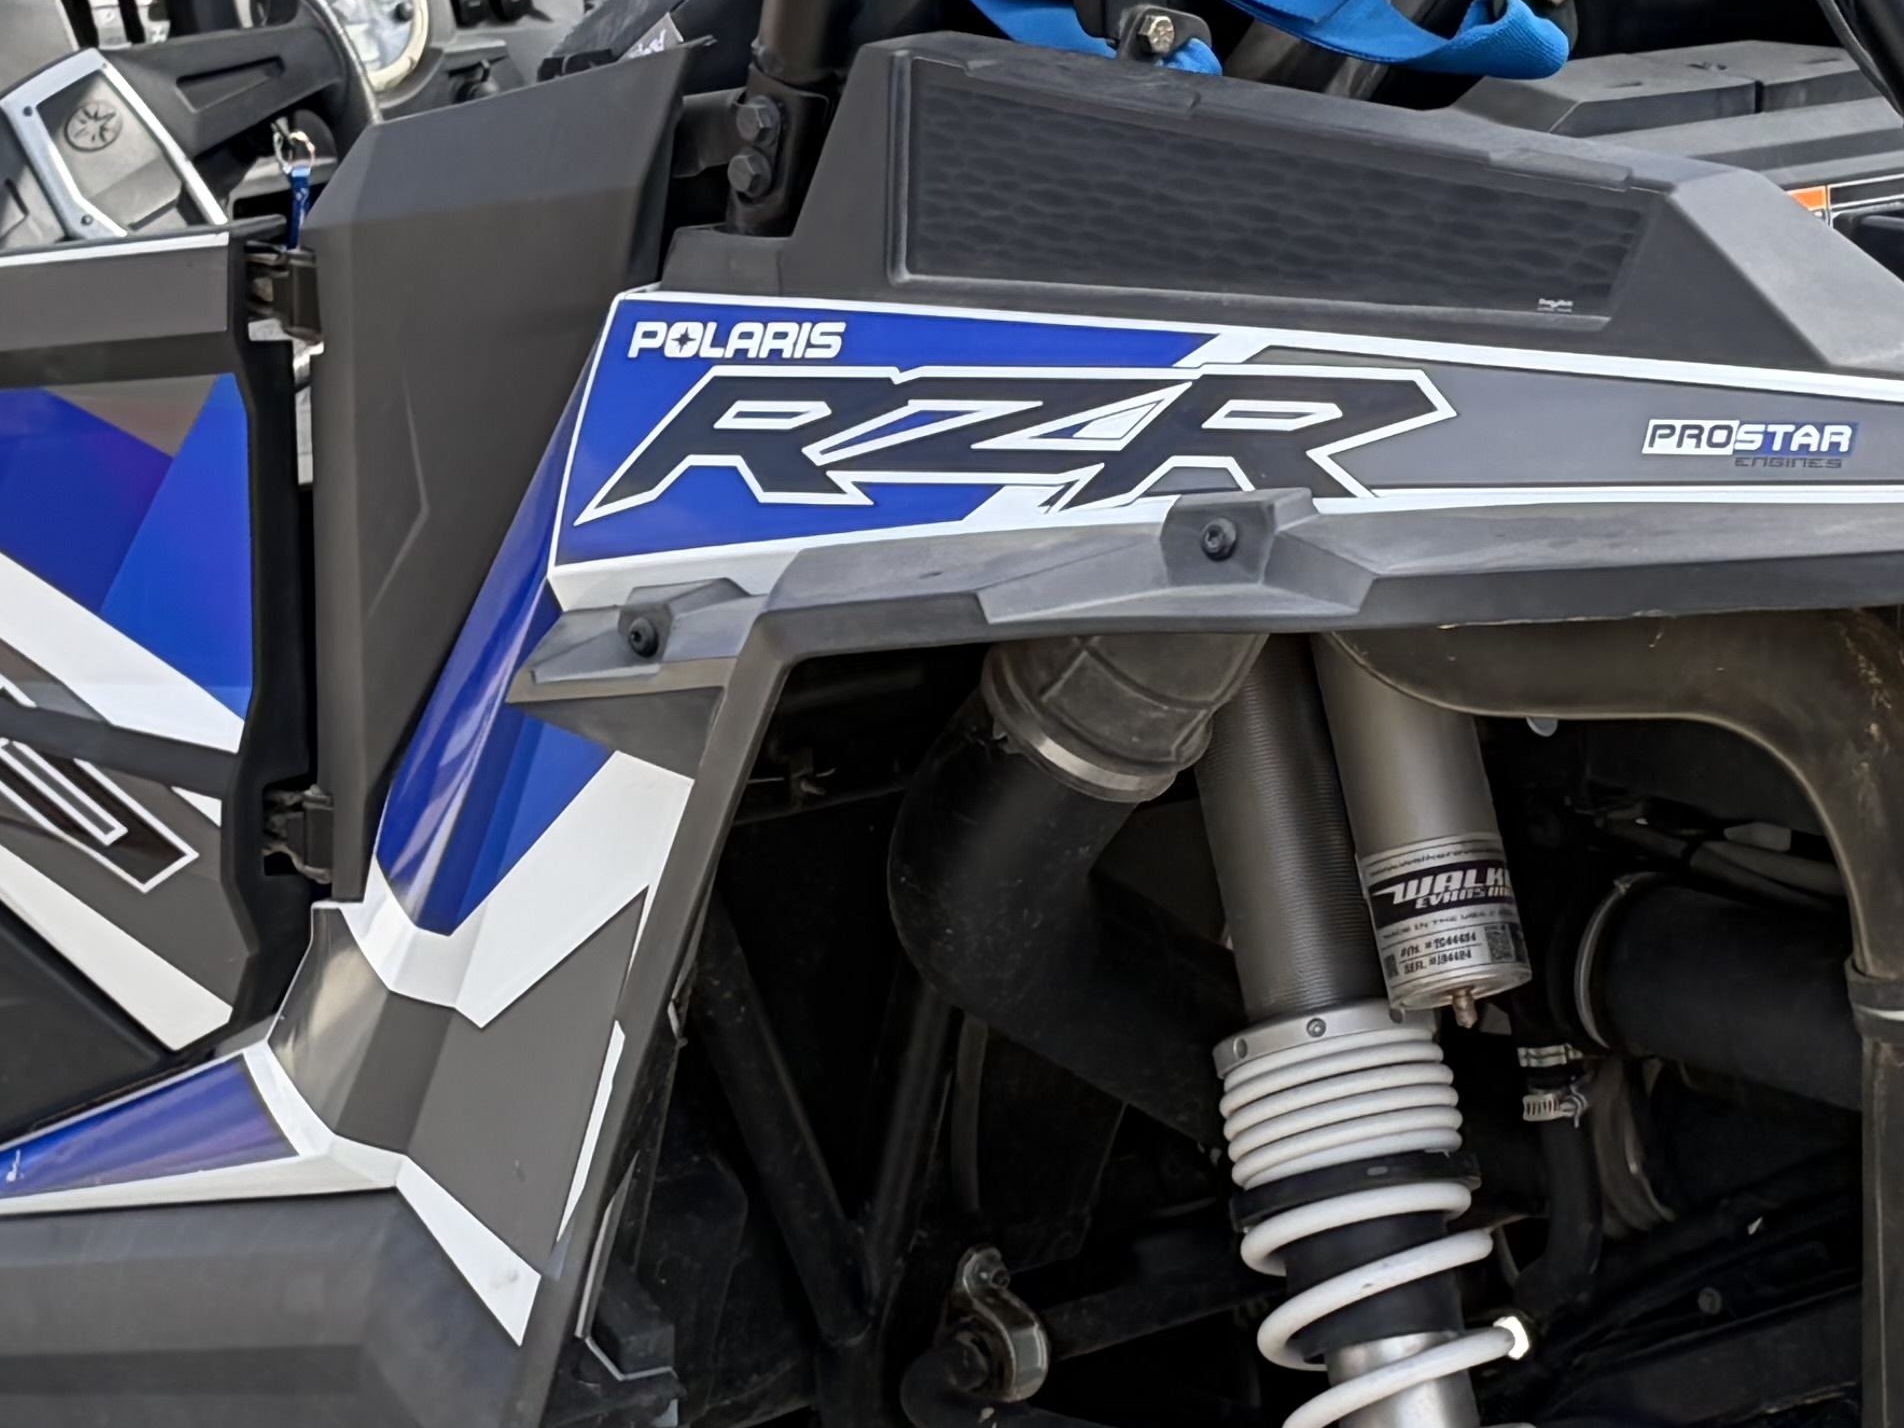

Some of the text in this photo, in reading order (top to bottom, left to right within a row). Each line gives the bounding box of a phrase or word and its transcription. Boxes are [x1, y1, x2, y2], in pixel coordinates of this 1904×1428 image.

[627, 320, 847, 360] POLARIS
[574, 365, 1457, 526] RZR
[1646, 422, 1853, 453] PROSTAR
[1734, 456, 1842, 468] ENGINES
